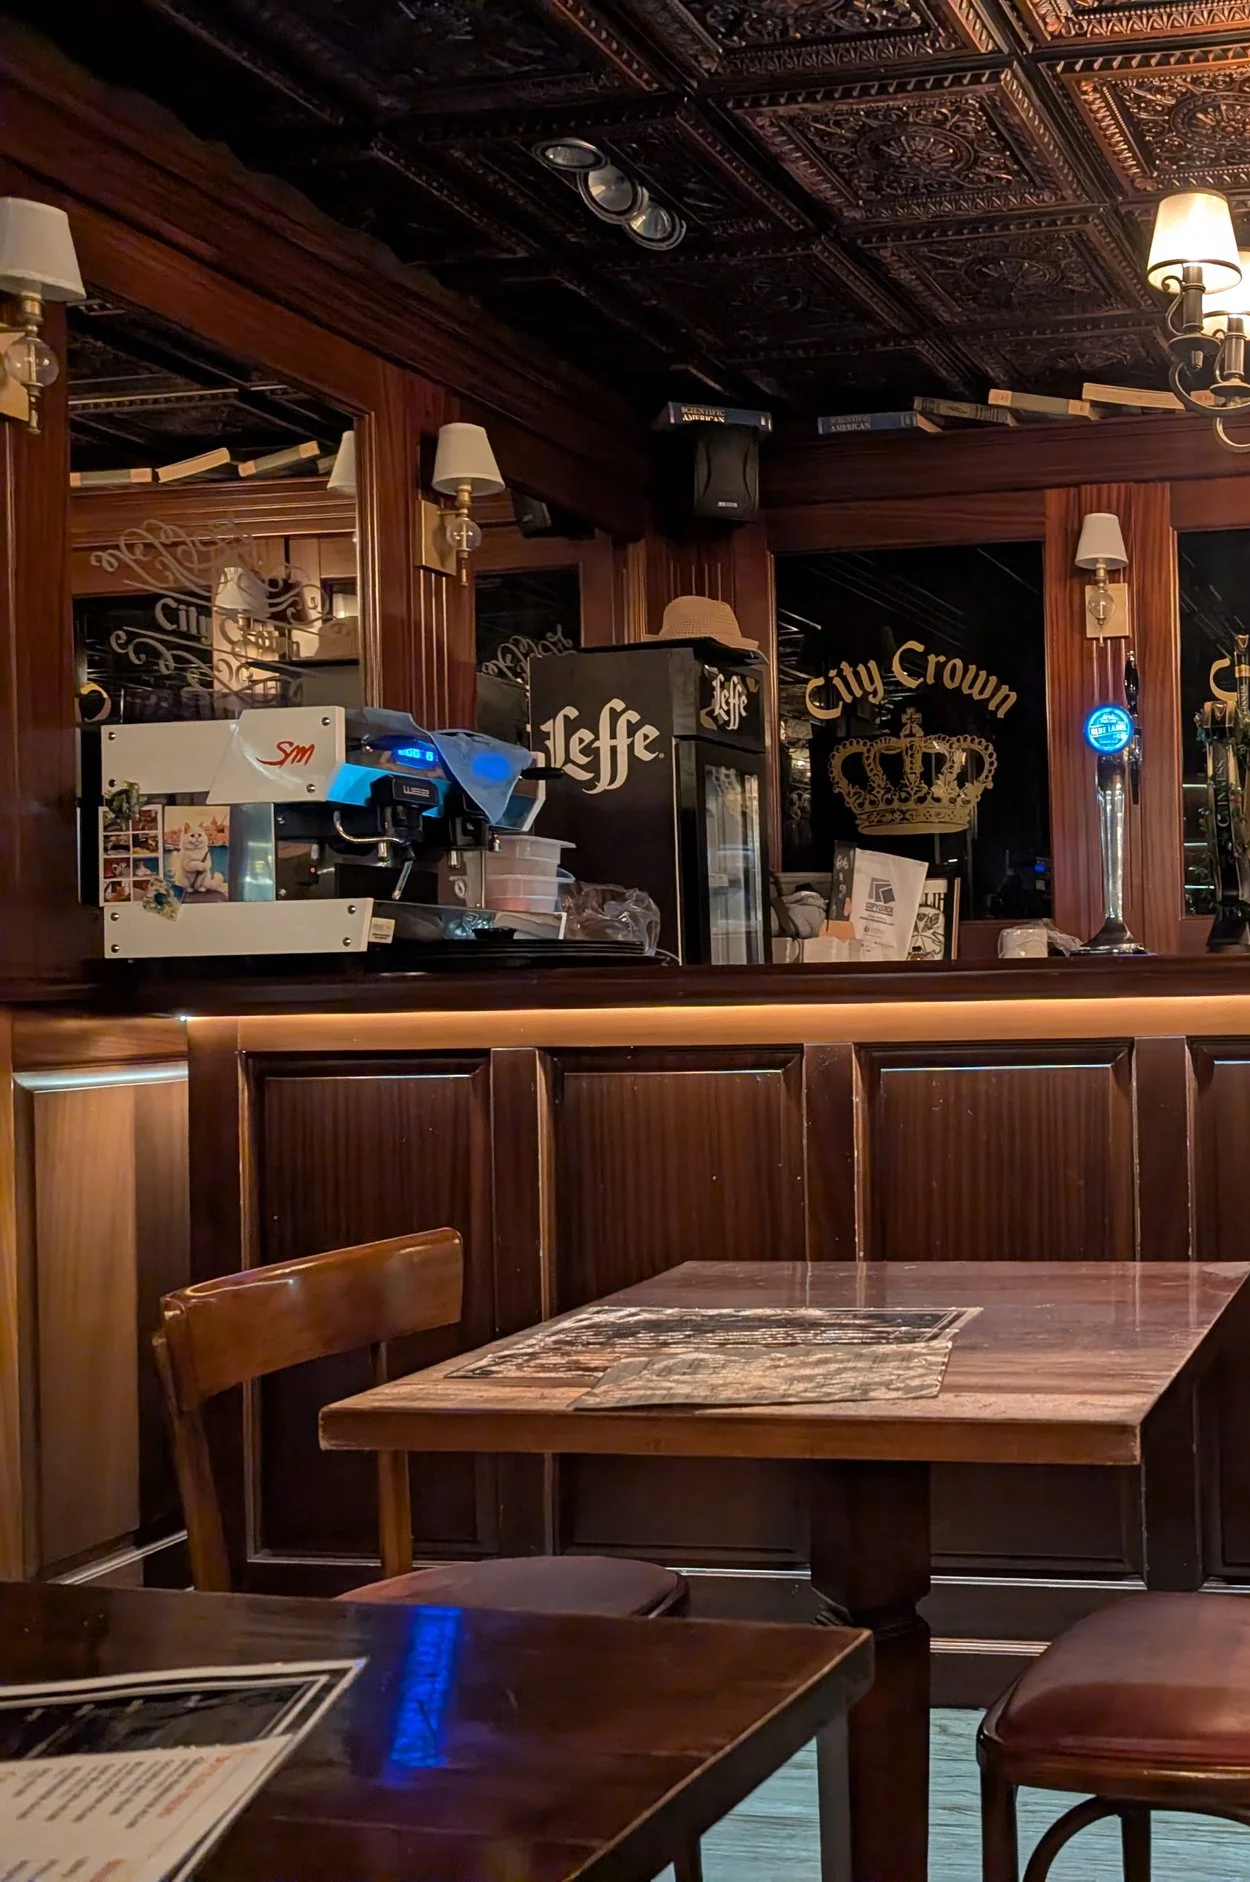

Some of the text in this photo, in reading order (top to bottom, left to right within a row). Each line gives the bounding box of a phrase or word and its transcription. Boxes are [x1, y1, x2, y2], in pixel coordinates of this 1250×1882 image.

[681, 406, 725, 417] SCIENTIFIC
[682, 414, 725, 423] AMERICAN
[831, 422, 871, 432] AMERICAN
[155, 598, 213, 646] City
[713, 674, 748, 730] Leffe
[805, 640, 1017, 720] City Crown
[540, 698, 660, 795] Leffe
